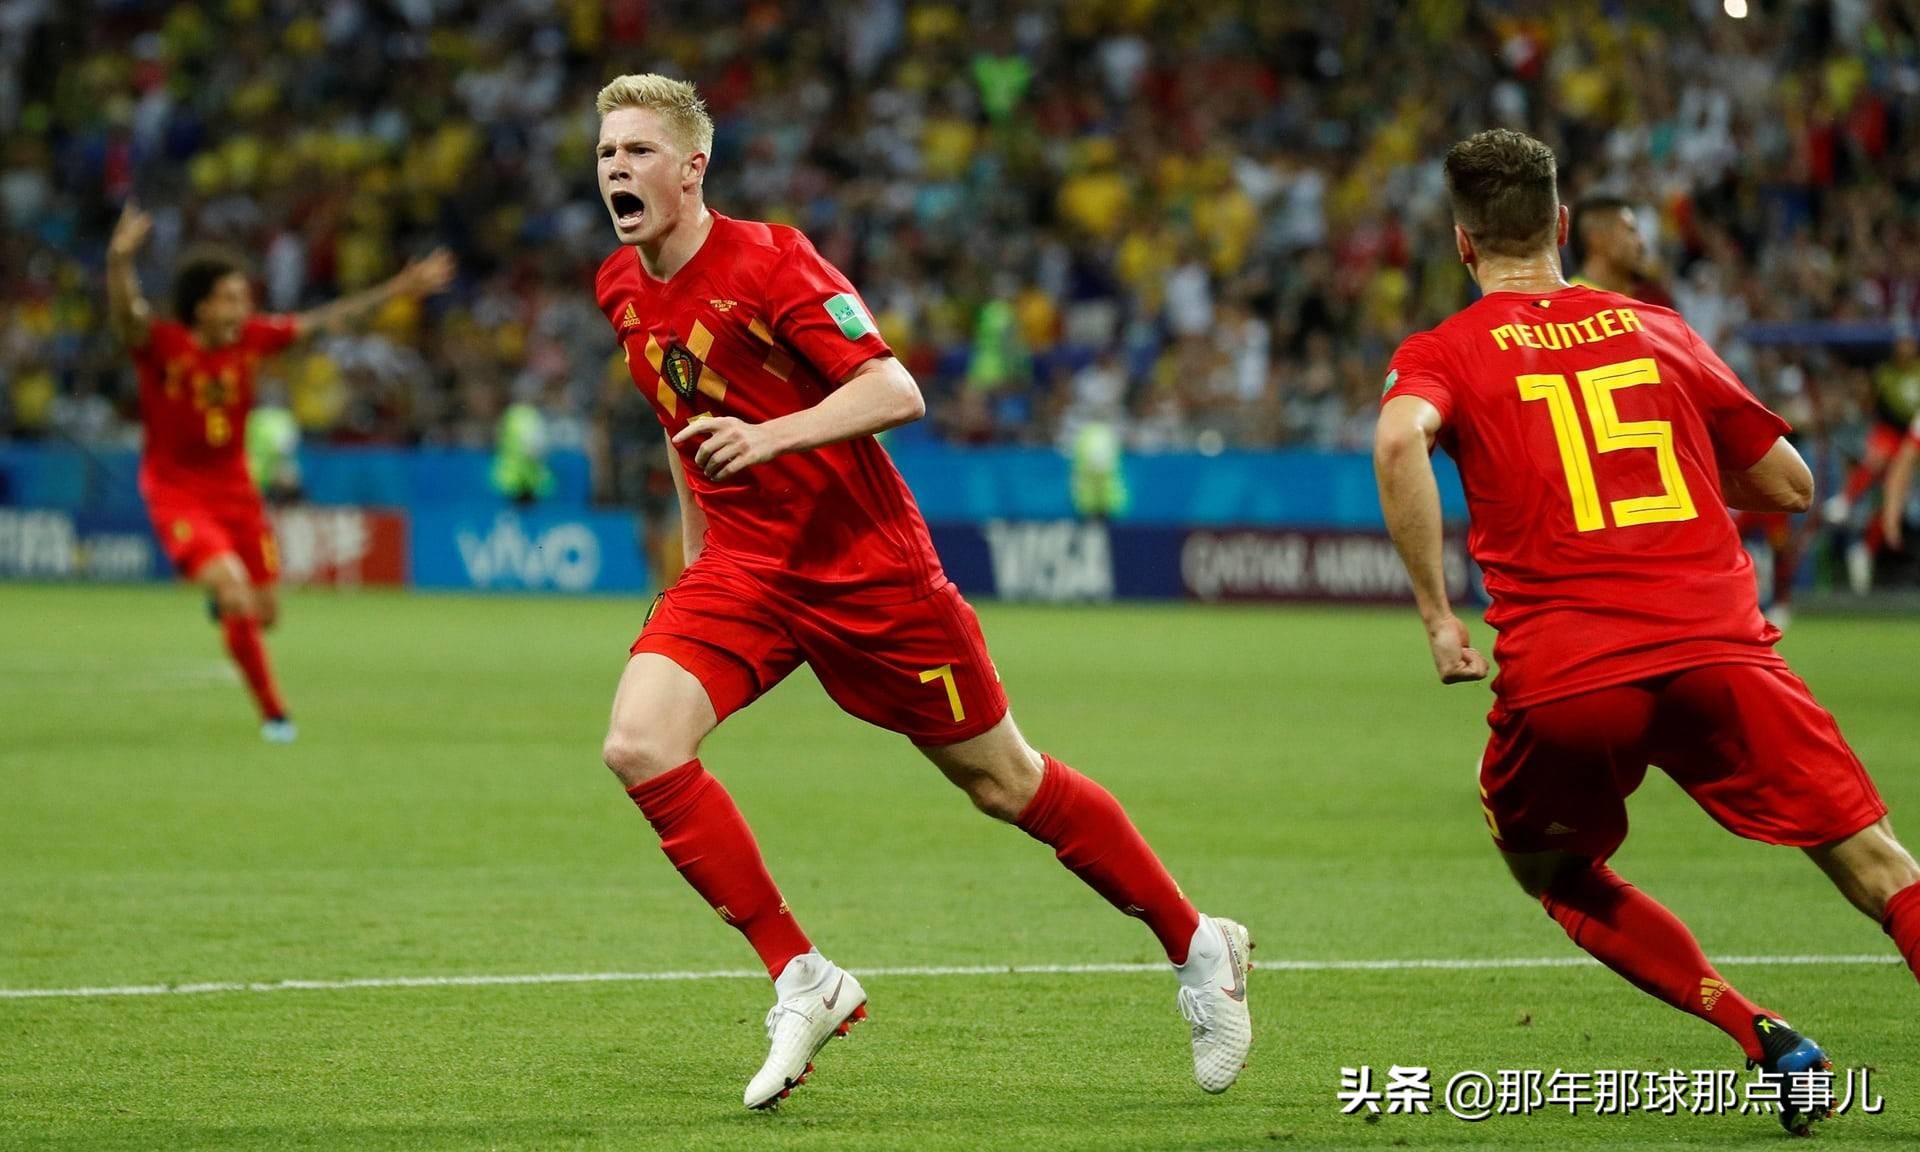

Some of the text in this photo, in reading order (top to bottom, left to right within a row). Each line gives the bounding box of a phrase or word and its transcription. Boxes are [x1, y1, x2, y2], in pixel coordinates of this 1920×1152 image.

[1489, 308, 1645, 351] MEUNIER
[1516, 358, 1699, 532] 15
[986, 520, 1115, 602] VISA
[919, 663, 966, 723] 7
